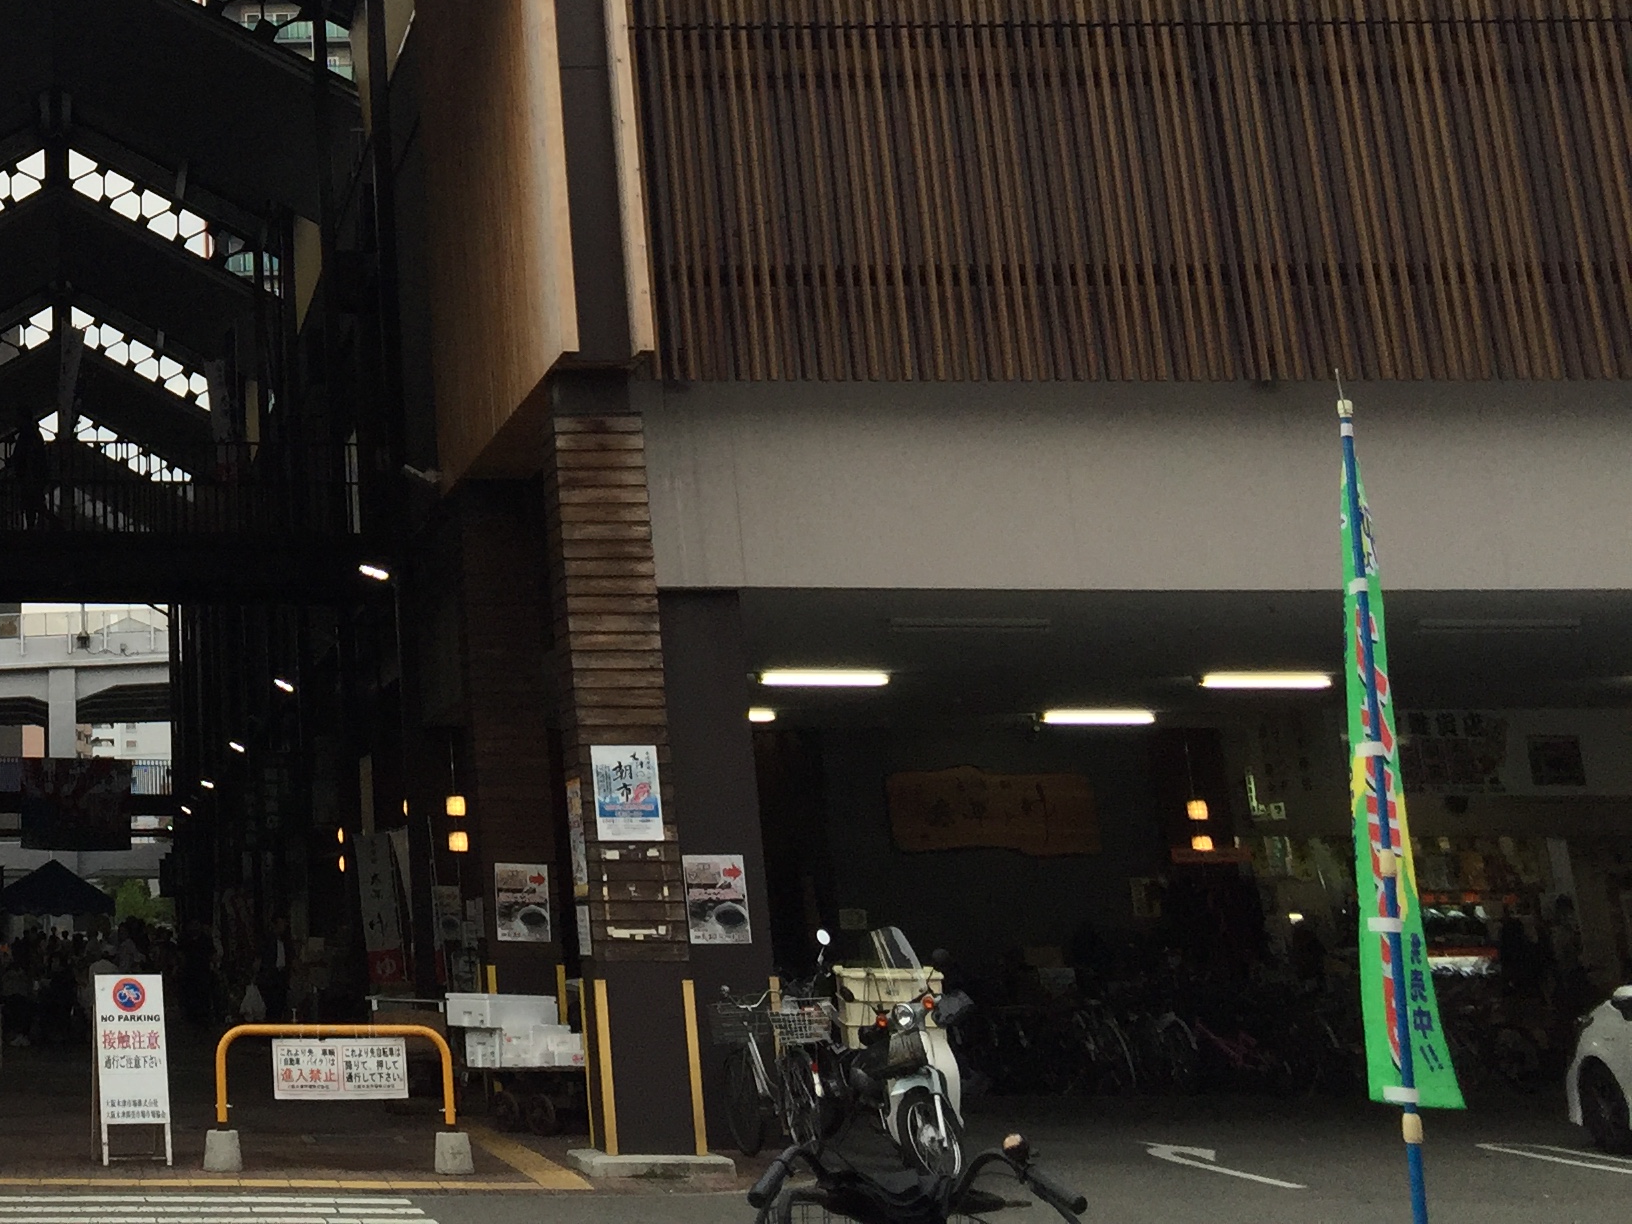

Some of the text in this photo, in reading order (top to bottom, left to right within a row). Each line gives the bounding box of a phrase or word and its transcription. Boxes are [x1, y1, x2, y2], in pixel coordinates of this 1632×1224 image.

[612, 760, 634, 803] 朝市
[101, 1014, 161, 1023] NO PARKING
[102, 1029, 161, 1051] 接触注意
[280, 1067, 337, 1083] 進入禁止
